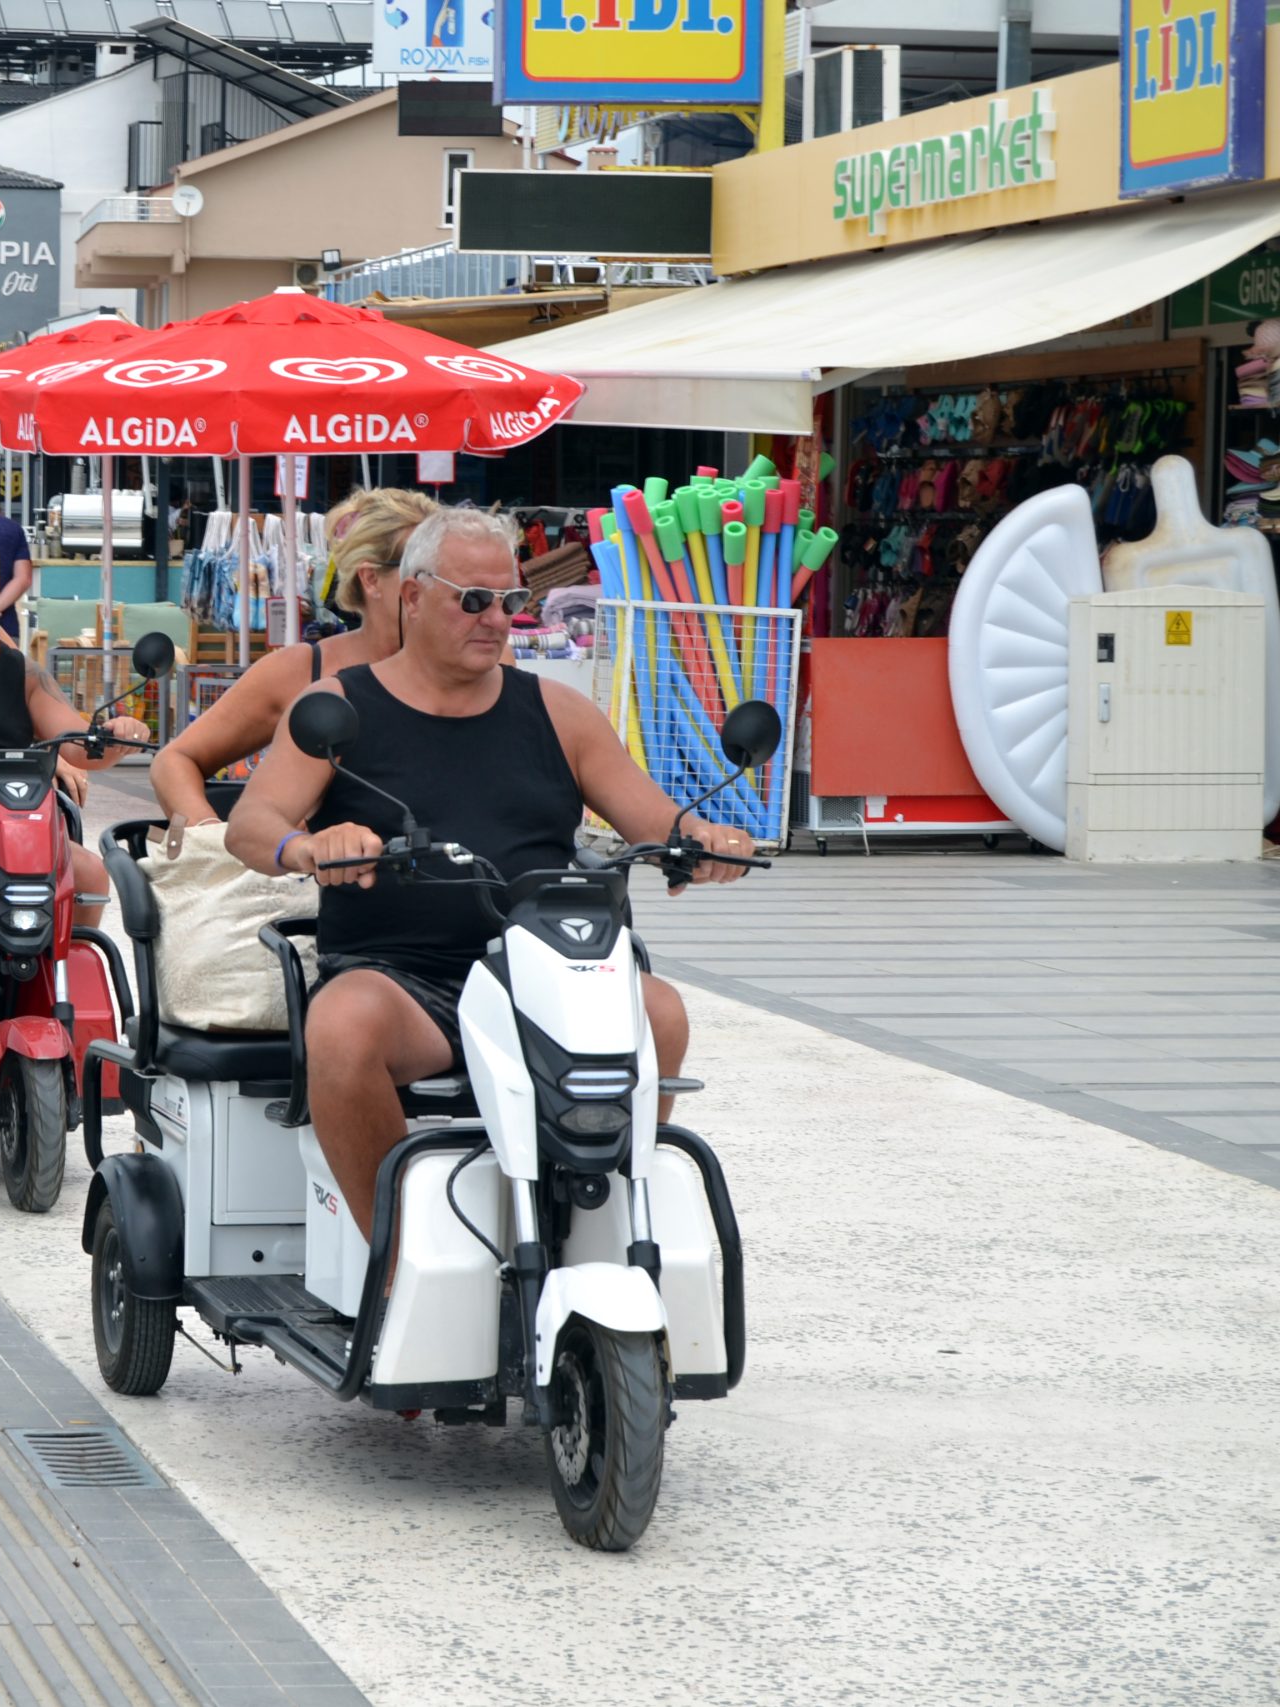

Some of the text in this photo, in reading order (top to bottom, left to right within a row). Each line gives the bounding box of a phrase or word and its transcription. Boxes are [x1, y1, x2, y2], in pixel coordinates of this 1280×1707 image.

[833, 90, 1050, 235] supermarket
[1, 271, 39, 296] Otel
[312, 1181, 338, 1215] RKS
